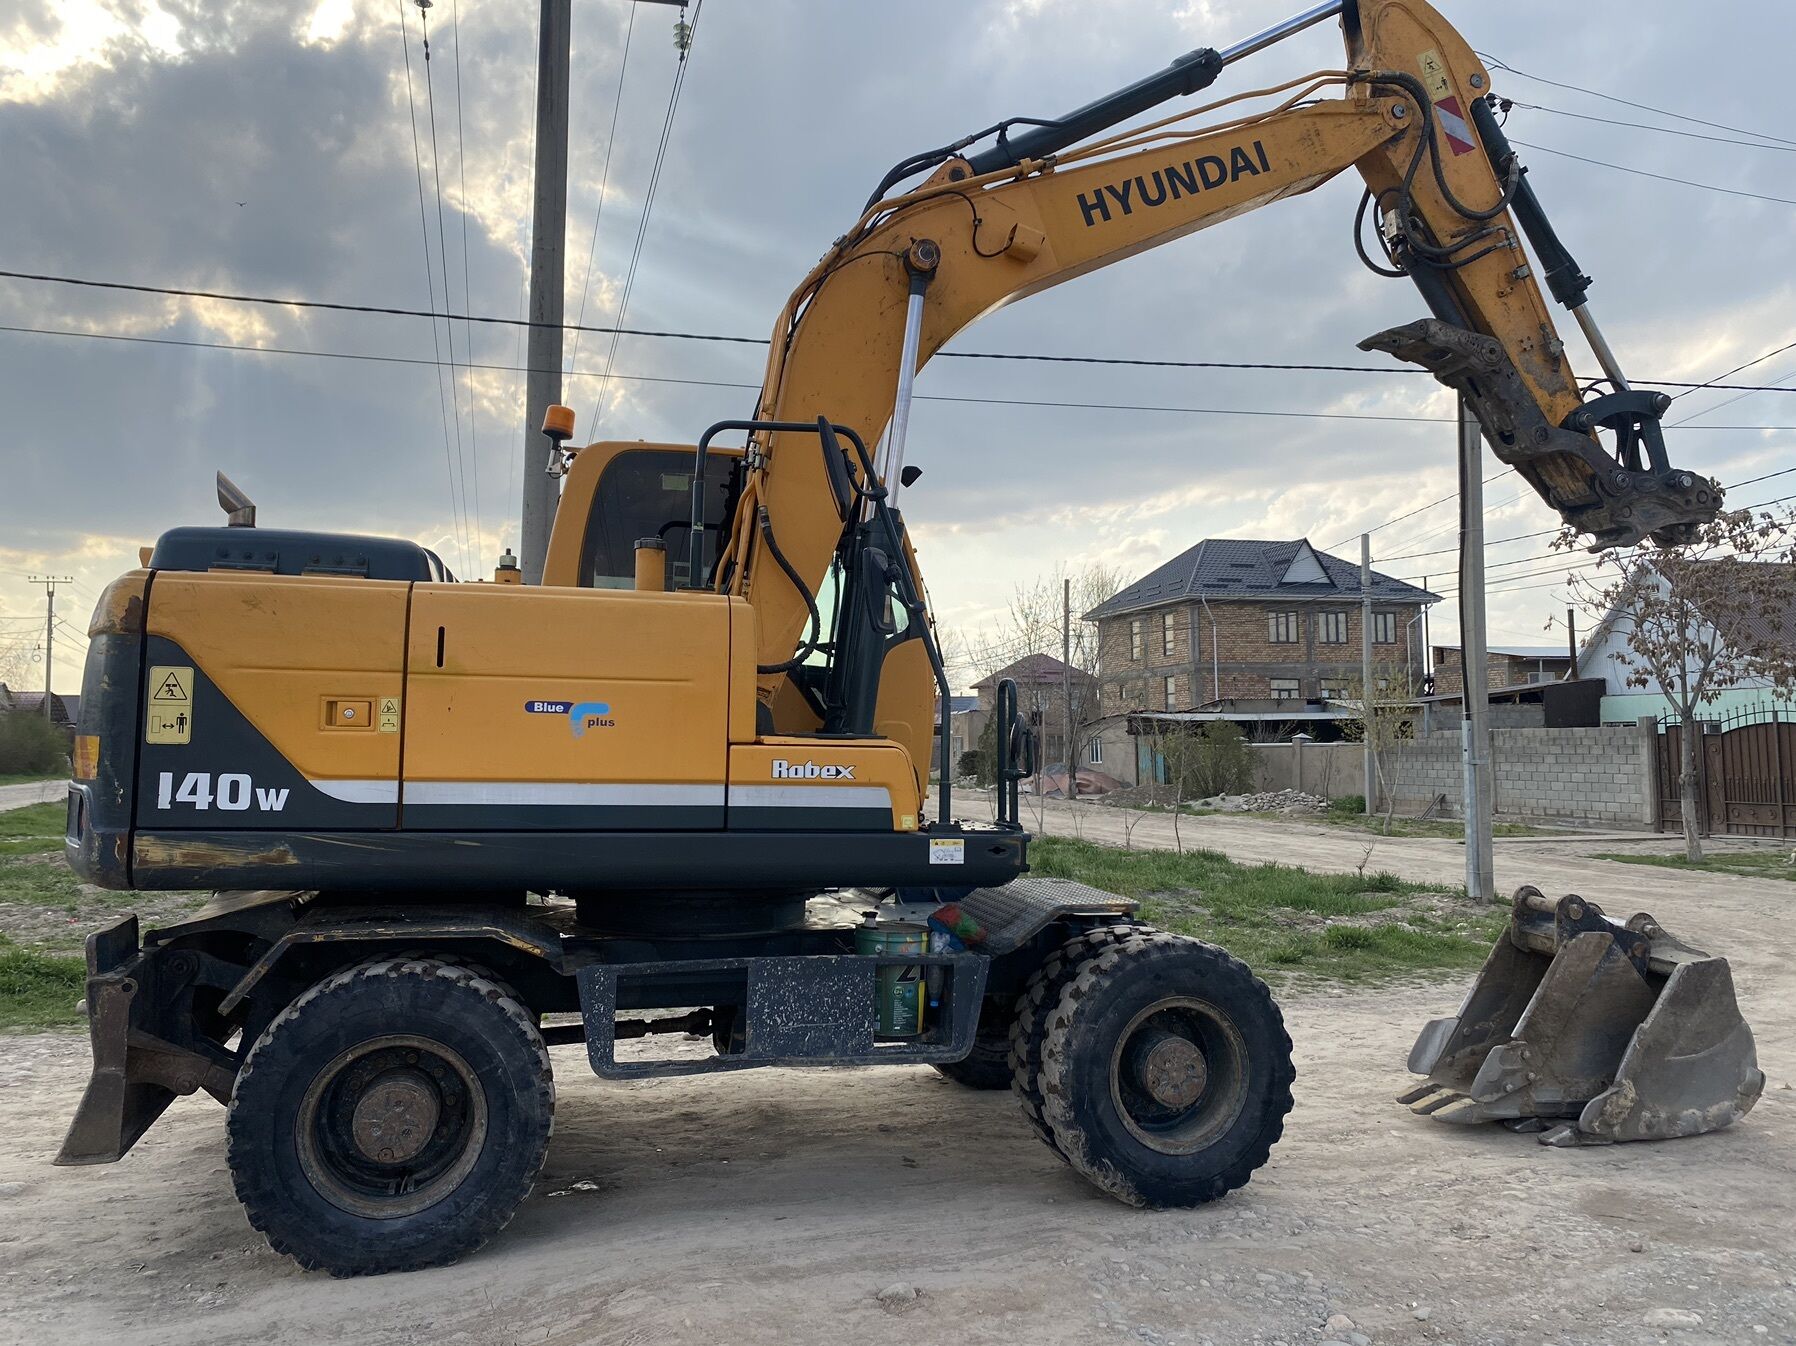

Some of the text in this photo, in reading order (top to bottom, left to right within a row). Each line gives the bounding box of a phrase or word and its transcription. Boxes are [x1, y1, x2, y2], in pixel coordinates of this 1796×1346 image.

[1076, 140, 1271, 227] HYUNDAI
[533, 702, 564, 713] Blue
[587, 717, 615, 728] plus
